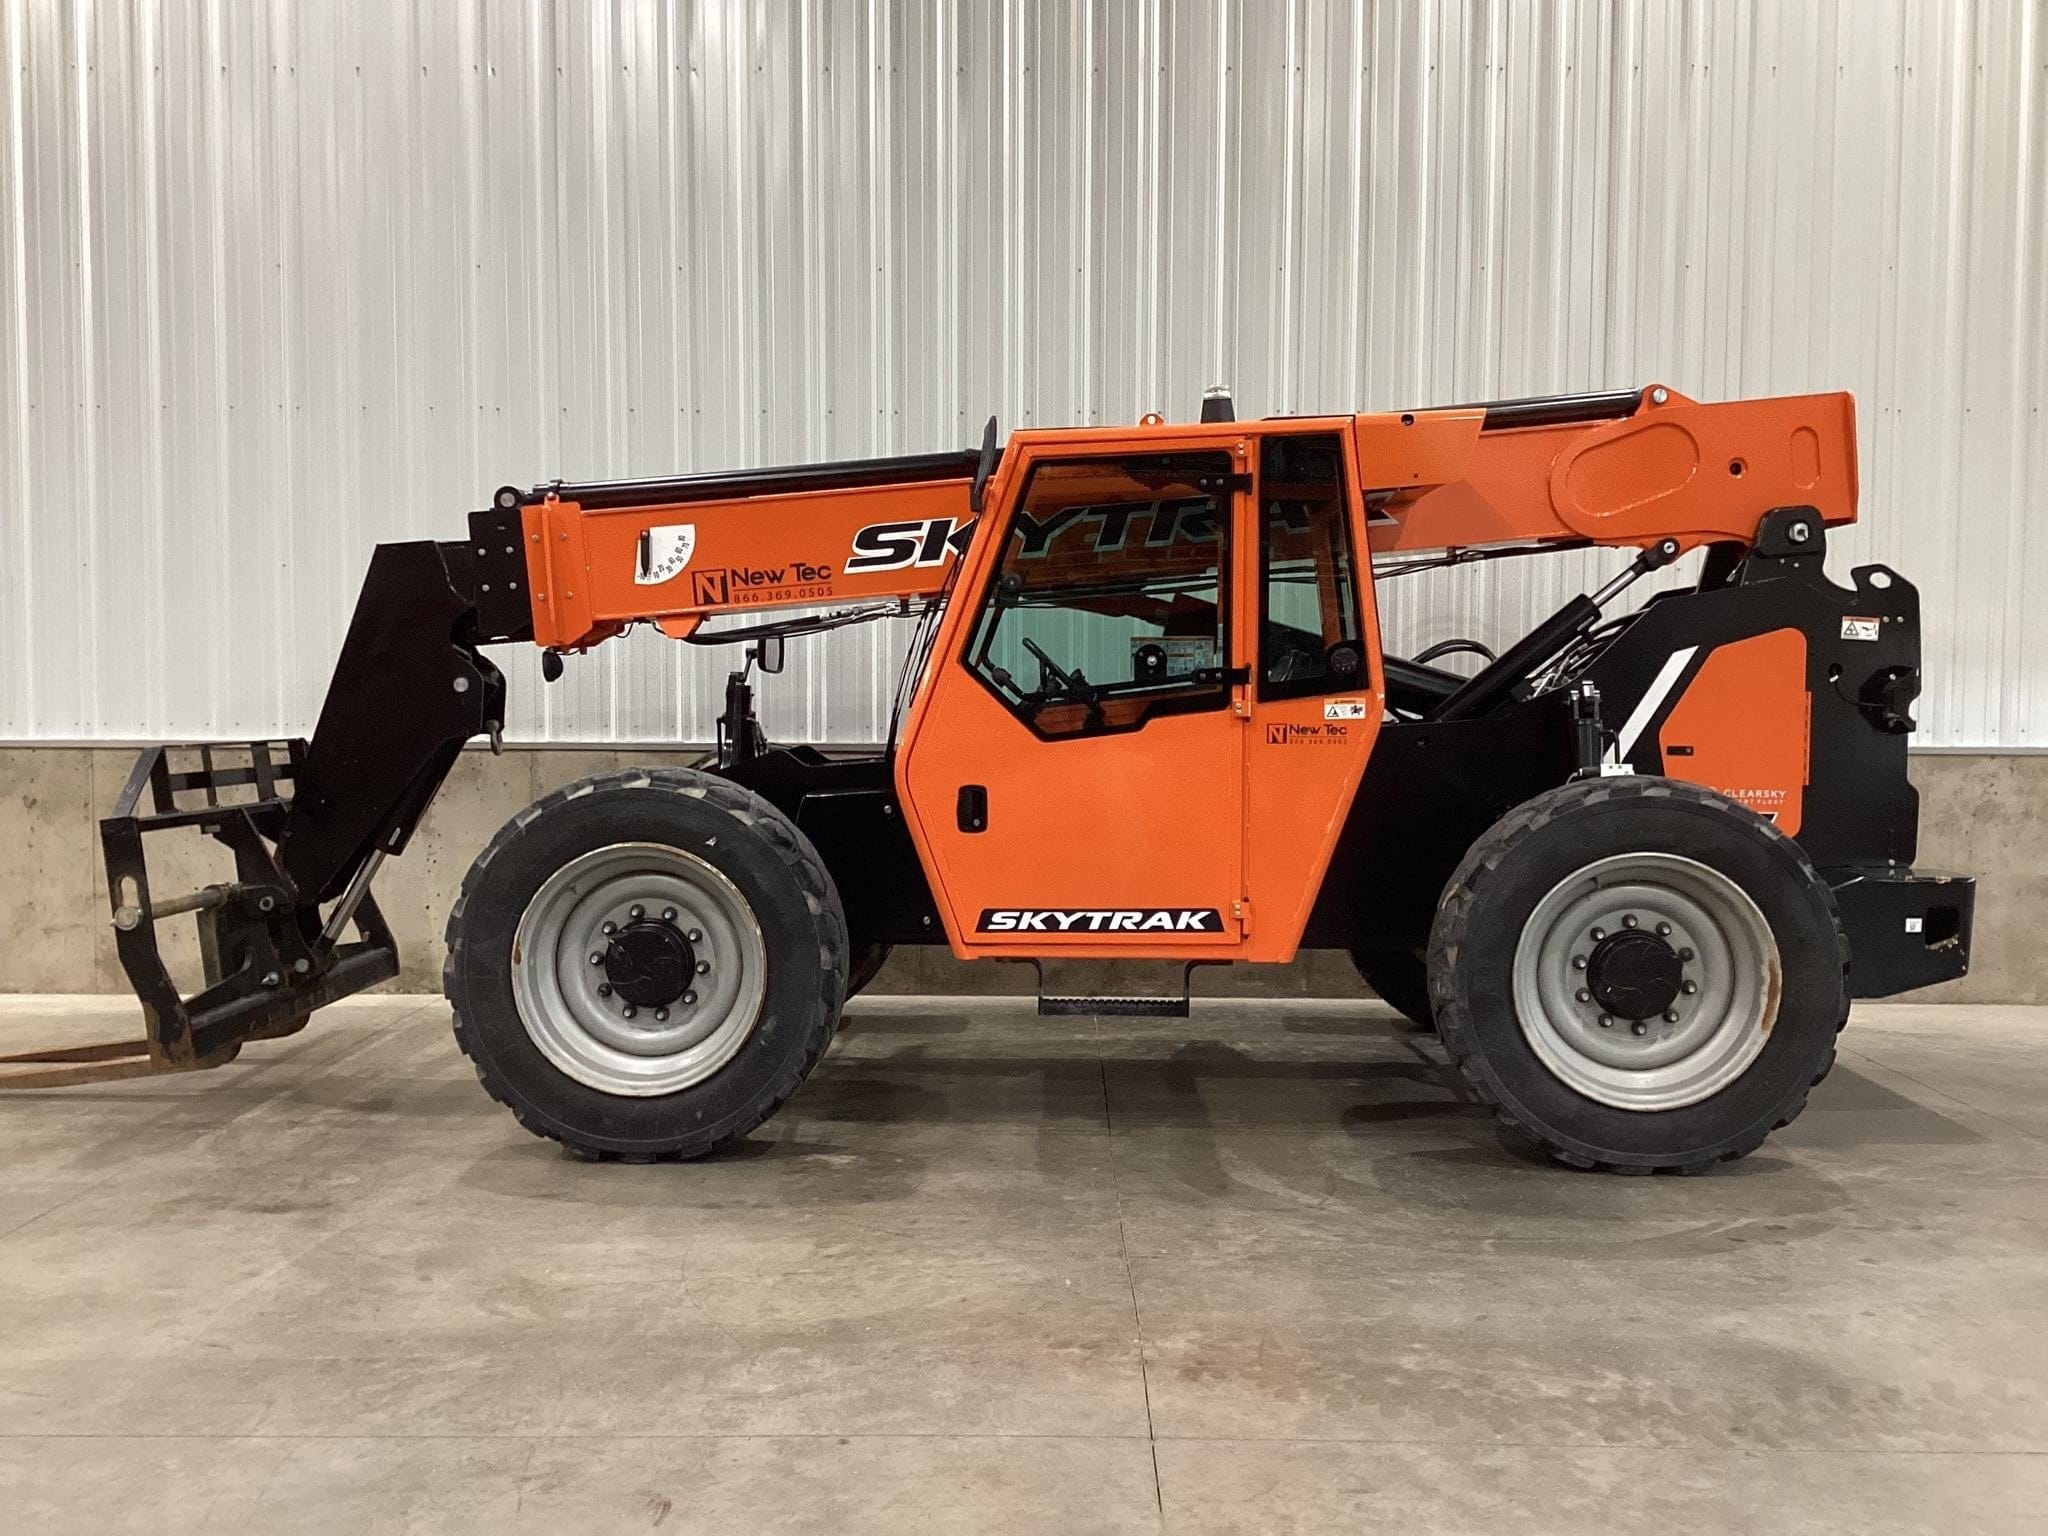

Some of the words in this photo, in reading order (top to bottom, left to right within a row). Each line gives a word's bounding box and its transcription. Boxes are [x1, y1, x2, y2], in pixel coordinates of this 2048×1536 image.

[731, 567, 786, 588] New
[789, 562, 832, 582] Tec
[733, 586, 833, 604] 866.369.0505
[1289, 724, 1321, 735] New
[1323, 723, 1347, 735] Tec
[1724, 788, 1786, 799] CLEARSKY
[987, 911, 1212, 930] SKYTRAK
